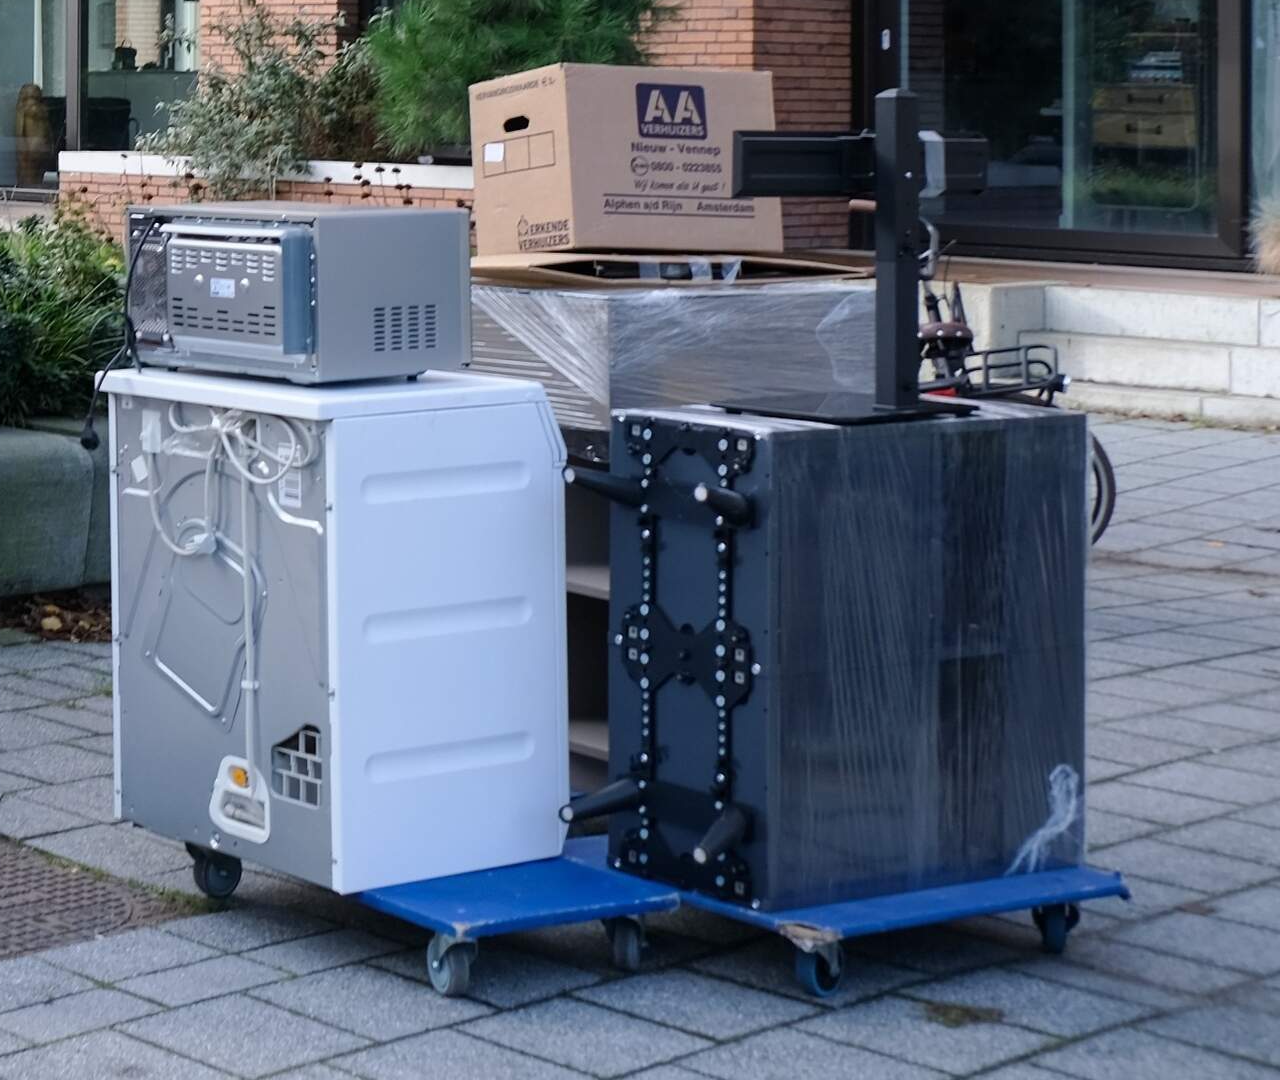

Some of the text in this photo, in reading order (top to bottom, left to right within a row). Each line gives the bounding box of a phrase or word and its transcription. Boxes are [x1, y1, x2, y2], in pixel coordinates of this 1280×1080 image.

[643, 89, 702, 124] AA
[640, 123, 704, 137] VERHUIZERS
[630, 141, 666, 153] Nieuw
[677, 143, 721, 156] Vennep
[603, 199, 641, 210] Alphen
[661, 201, 683, 213] Rijn
[696, 202, 755, 213] Amsterdam
